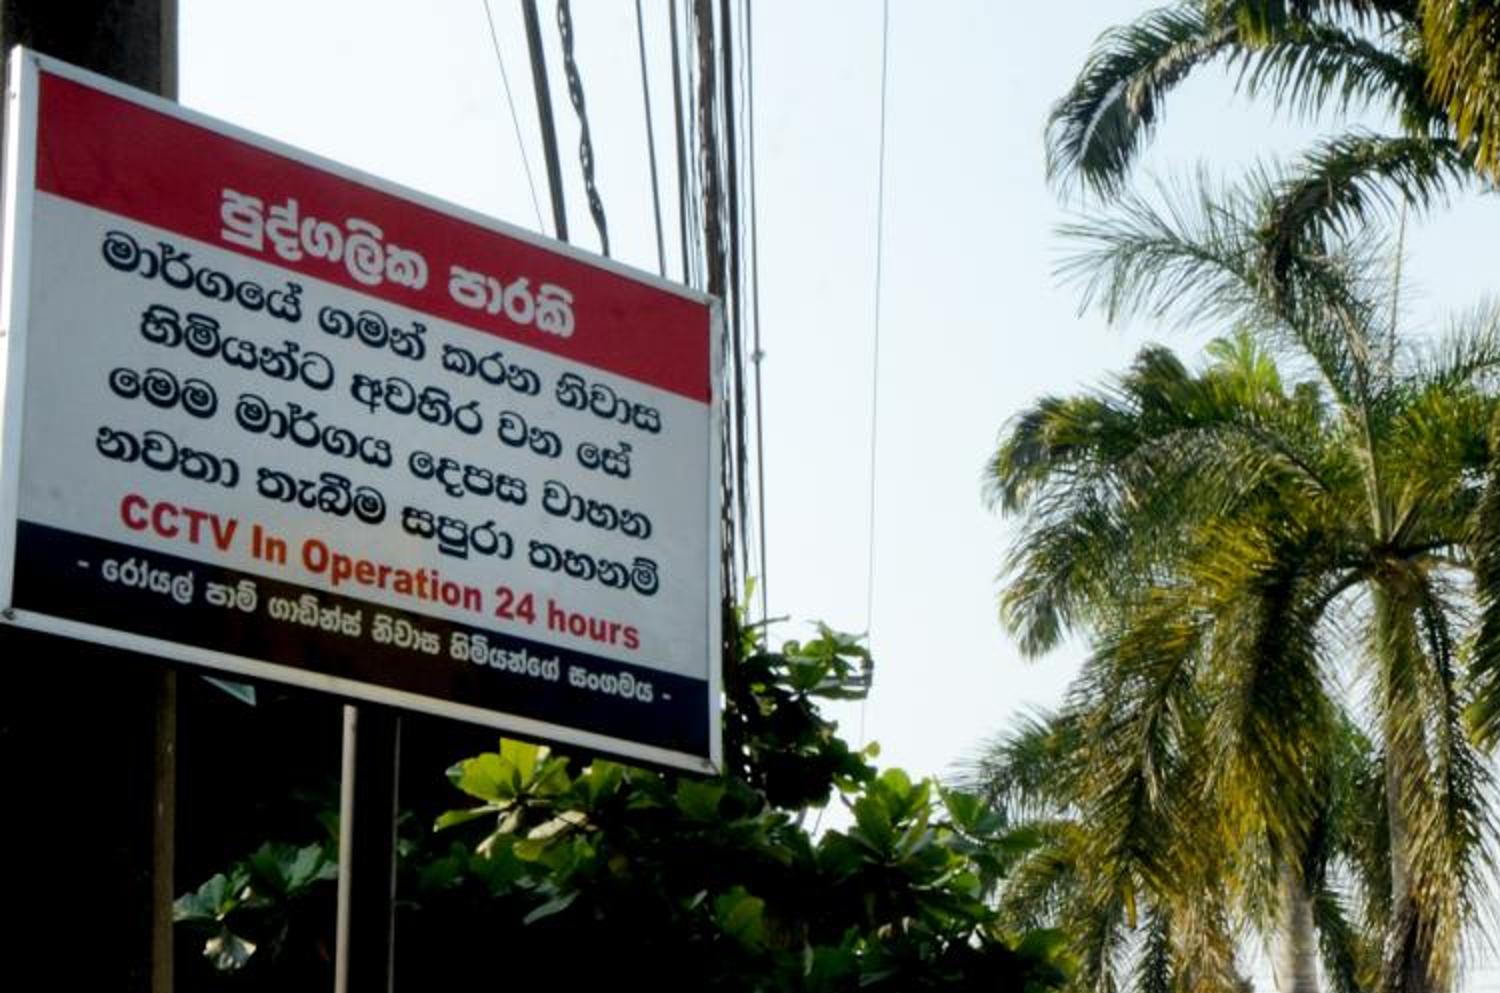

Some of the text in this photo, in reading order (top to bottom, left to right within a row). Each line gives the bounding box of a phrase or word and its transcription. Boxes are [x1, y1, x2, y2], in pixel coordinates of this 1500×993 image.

[102, 230, 662, 434] මාර්ගයේ ගමන් කරන නිවාස
[141, 304, 632, 479] හිමියන්ට අවහිර වන සේ
[96, 425, 660, 597] නවතා තැබීම සපුරා තහනම්
[109, 367, 652, 541] මෙම මාර්ගය දෙපස වාහන
[120, 494, 640, 650] CCTV In Operation 24 hours
[371, 613, 441, 655] නිවාස
[568, 667, 654, 703] සංගමය
